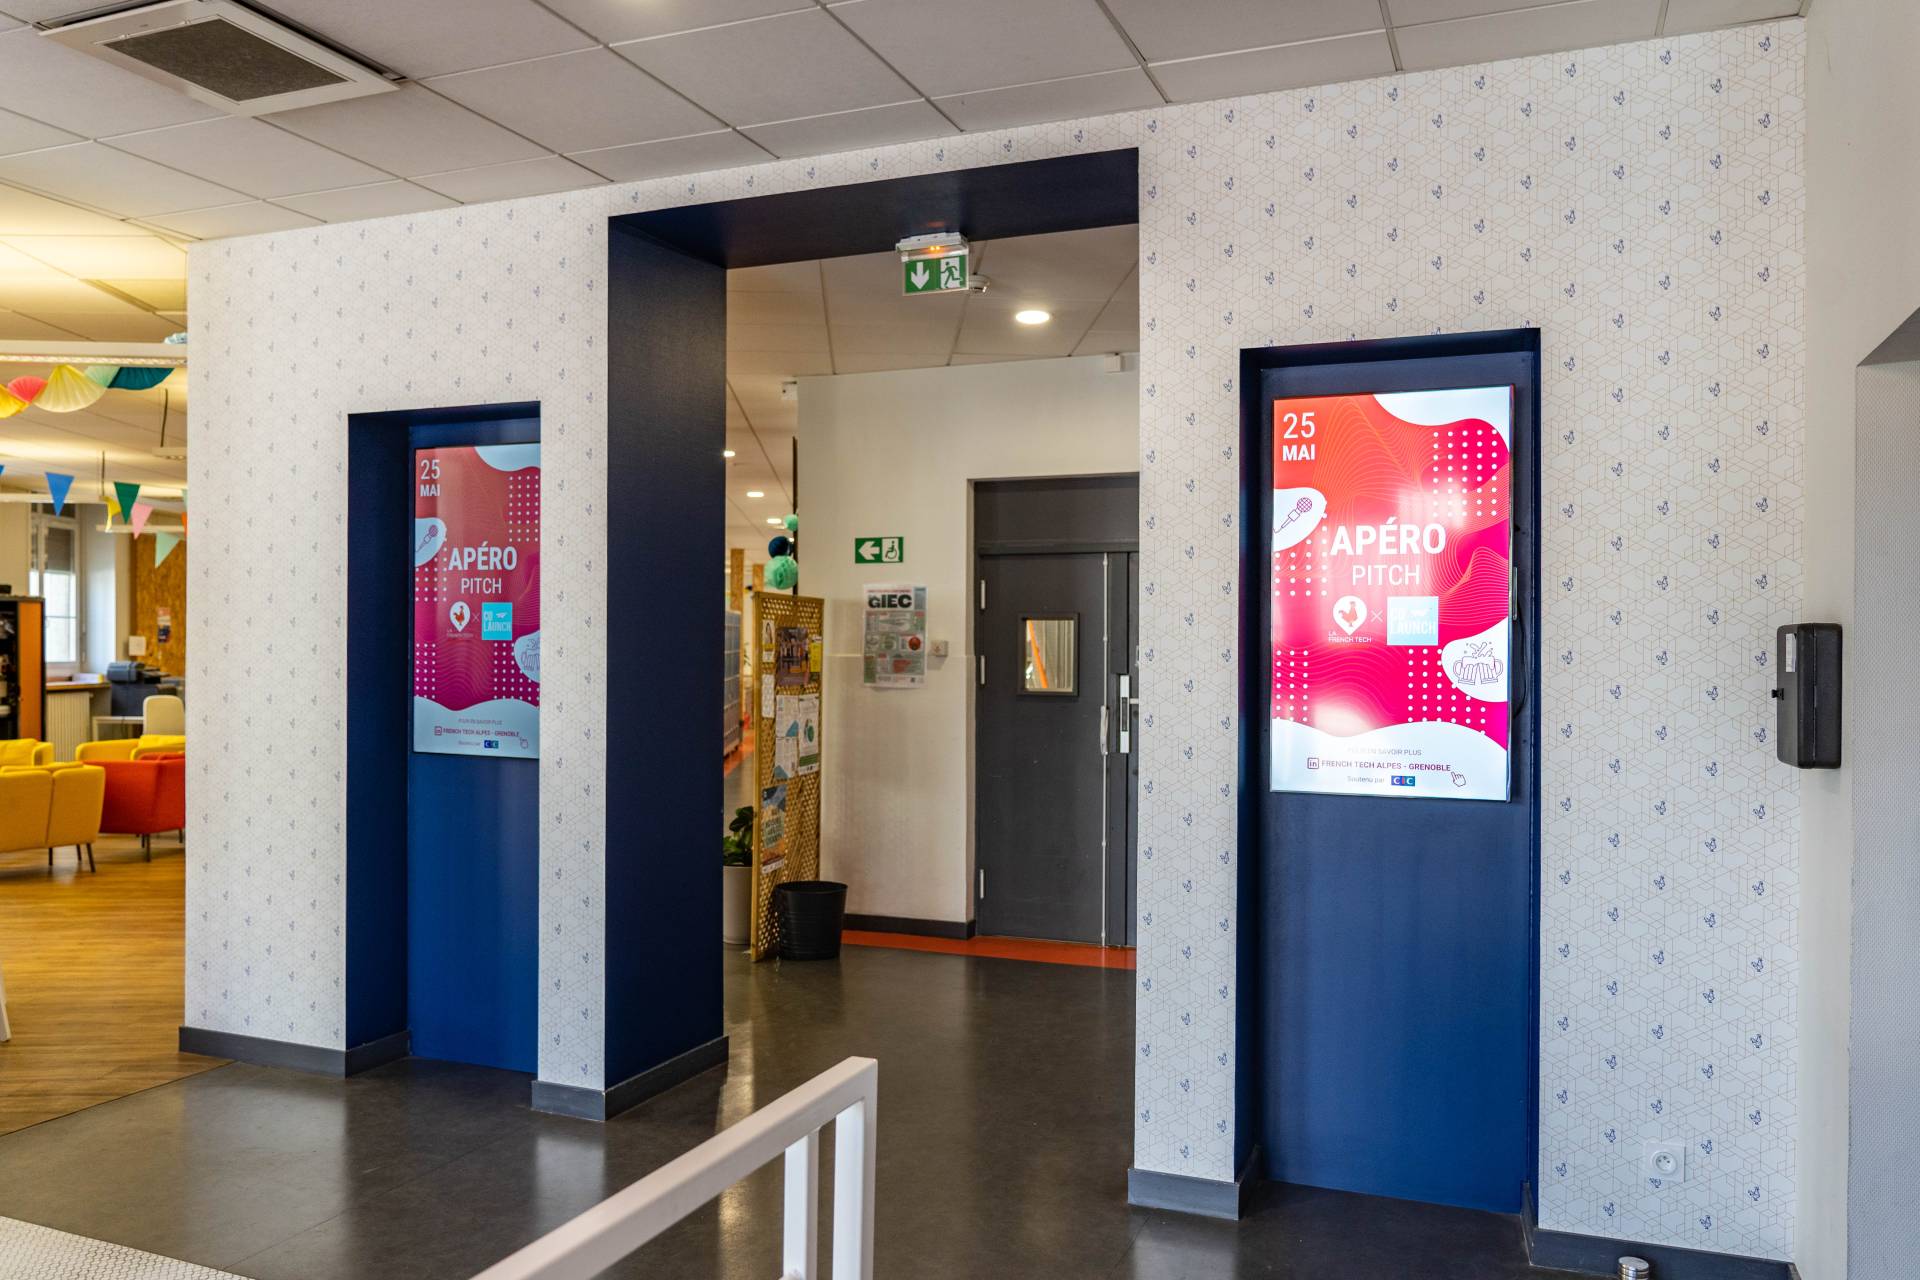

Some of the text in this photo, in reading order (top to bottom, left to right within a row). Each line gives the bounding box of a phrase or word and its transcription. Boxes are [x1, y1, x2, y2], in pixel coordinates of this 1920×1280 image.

[1283, 412, 1315, 439] 25
[1282, 444, 1315, 461] MAI
[421, 459, 440, 480] 25
[420, 484, 440, 497] MAI
[1330, 516, 1446, 555] APÉRO
[448, 541, 517, 571] APÉRO
[1352, 564, 1420, 586] PITCH
[461, 577, 502, 594] PITCH
[868, 594, 912, 608] GIEC
[483, 621, 512, 632] LAUNCH
[1321, 760, 1352, 768] FRENCH
[1354, 761, 1375, 769] TECH
[1376, 762, 1402, 770] ALPES
[1408, 763, 1451, 772] GRENOBLE
[1393, 777, 1414, 785] CIC
